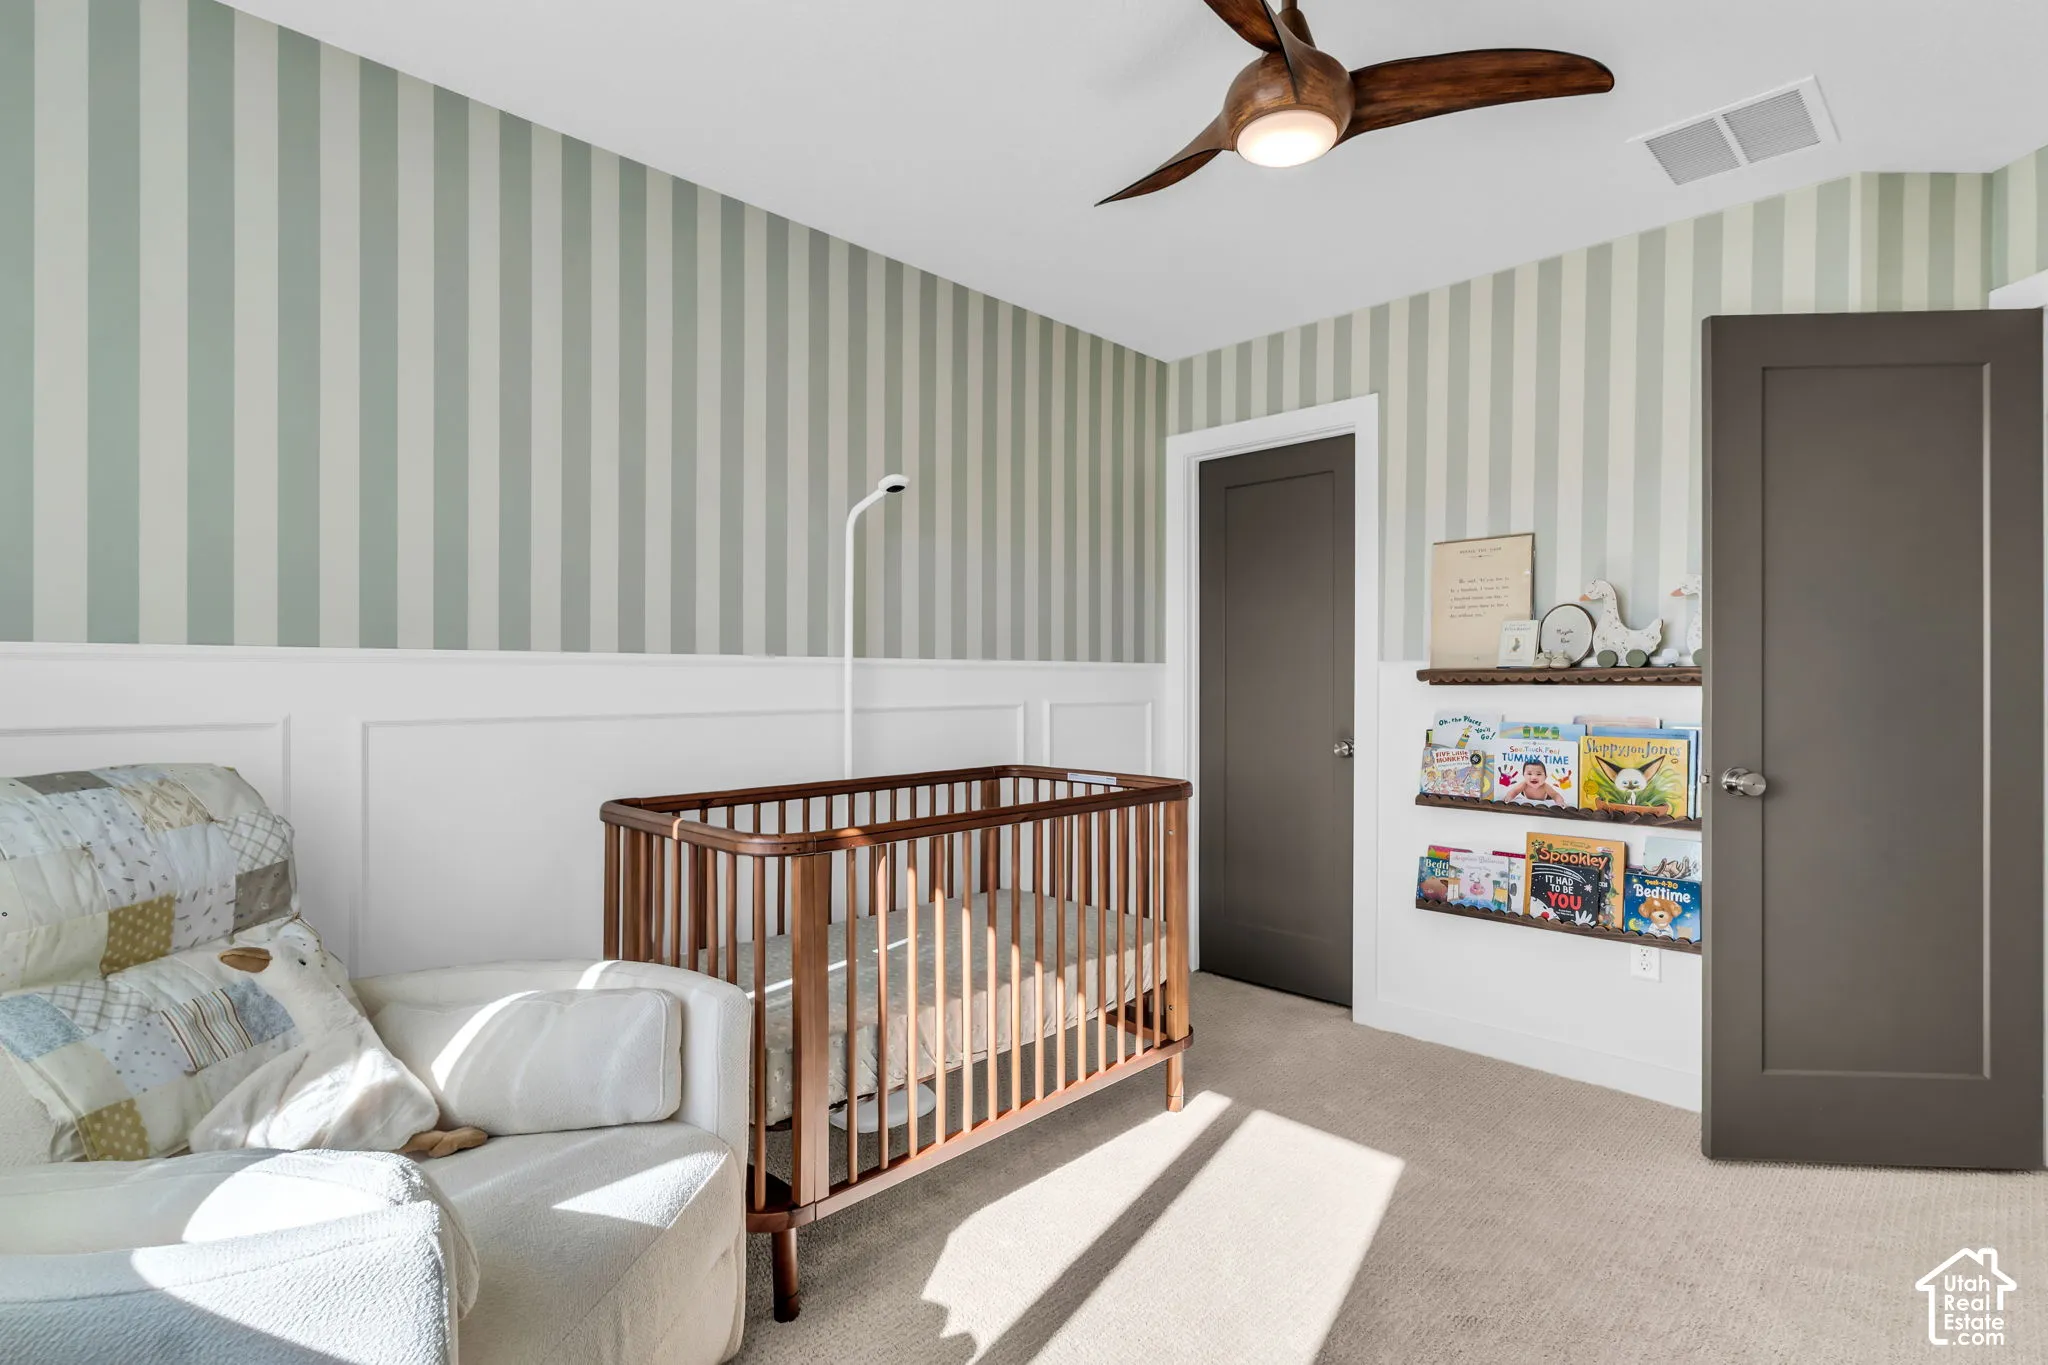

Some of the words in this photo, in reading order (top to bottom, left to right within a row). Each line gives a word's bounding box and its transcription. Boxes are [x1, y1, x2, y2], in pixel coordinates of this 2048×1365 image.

[1463, 715, 1482, 726] Places
[1481, 732, 1496, 740] Go!
[1584, 737, 1644, 758] Skippyjon
[1642, 741, 1682, 758] Jones
[1436, 756, 1469, 764] MONKEYS
[1502, 752, 1540, 763] TUMMY
[1543, 754, 1569, 765] TIME
[1425, 858, 1449, 870] Bedti
[1539, 847, 1608, 870] Spookley
[1545, 874, 1554, 884] IT
[1555, 876, 1574, 886] HAD
[1549, 883, 1560, 893] TO
[1562, 885, 1574, 895] BE
[1633, 883, 1691, 903] Bedtime
[1547, 891, 1582, 911] YOU
